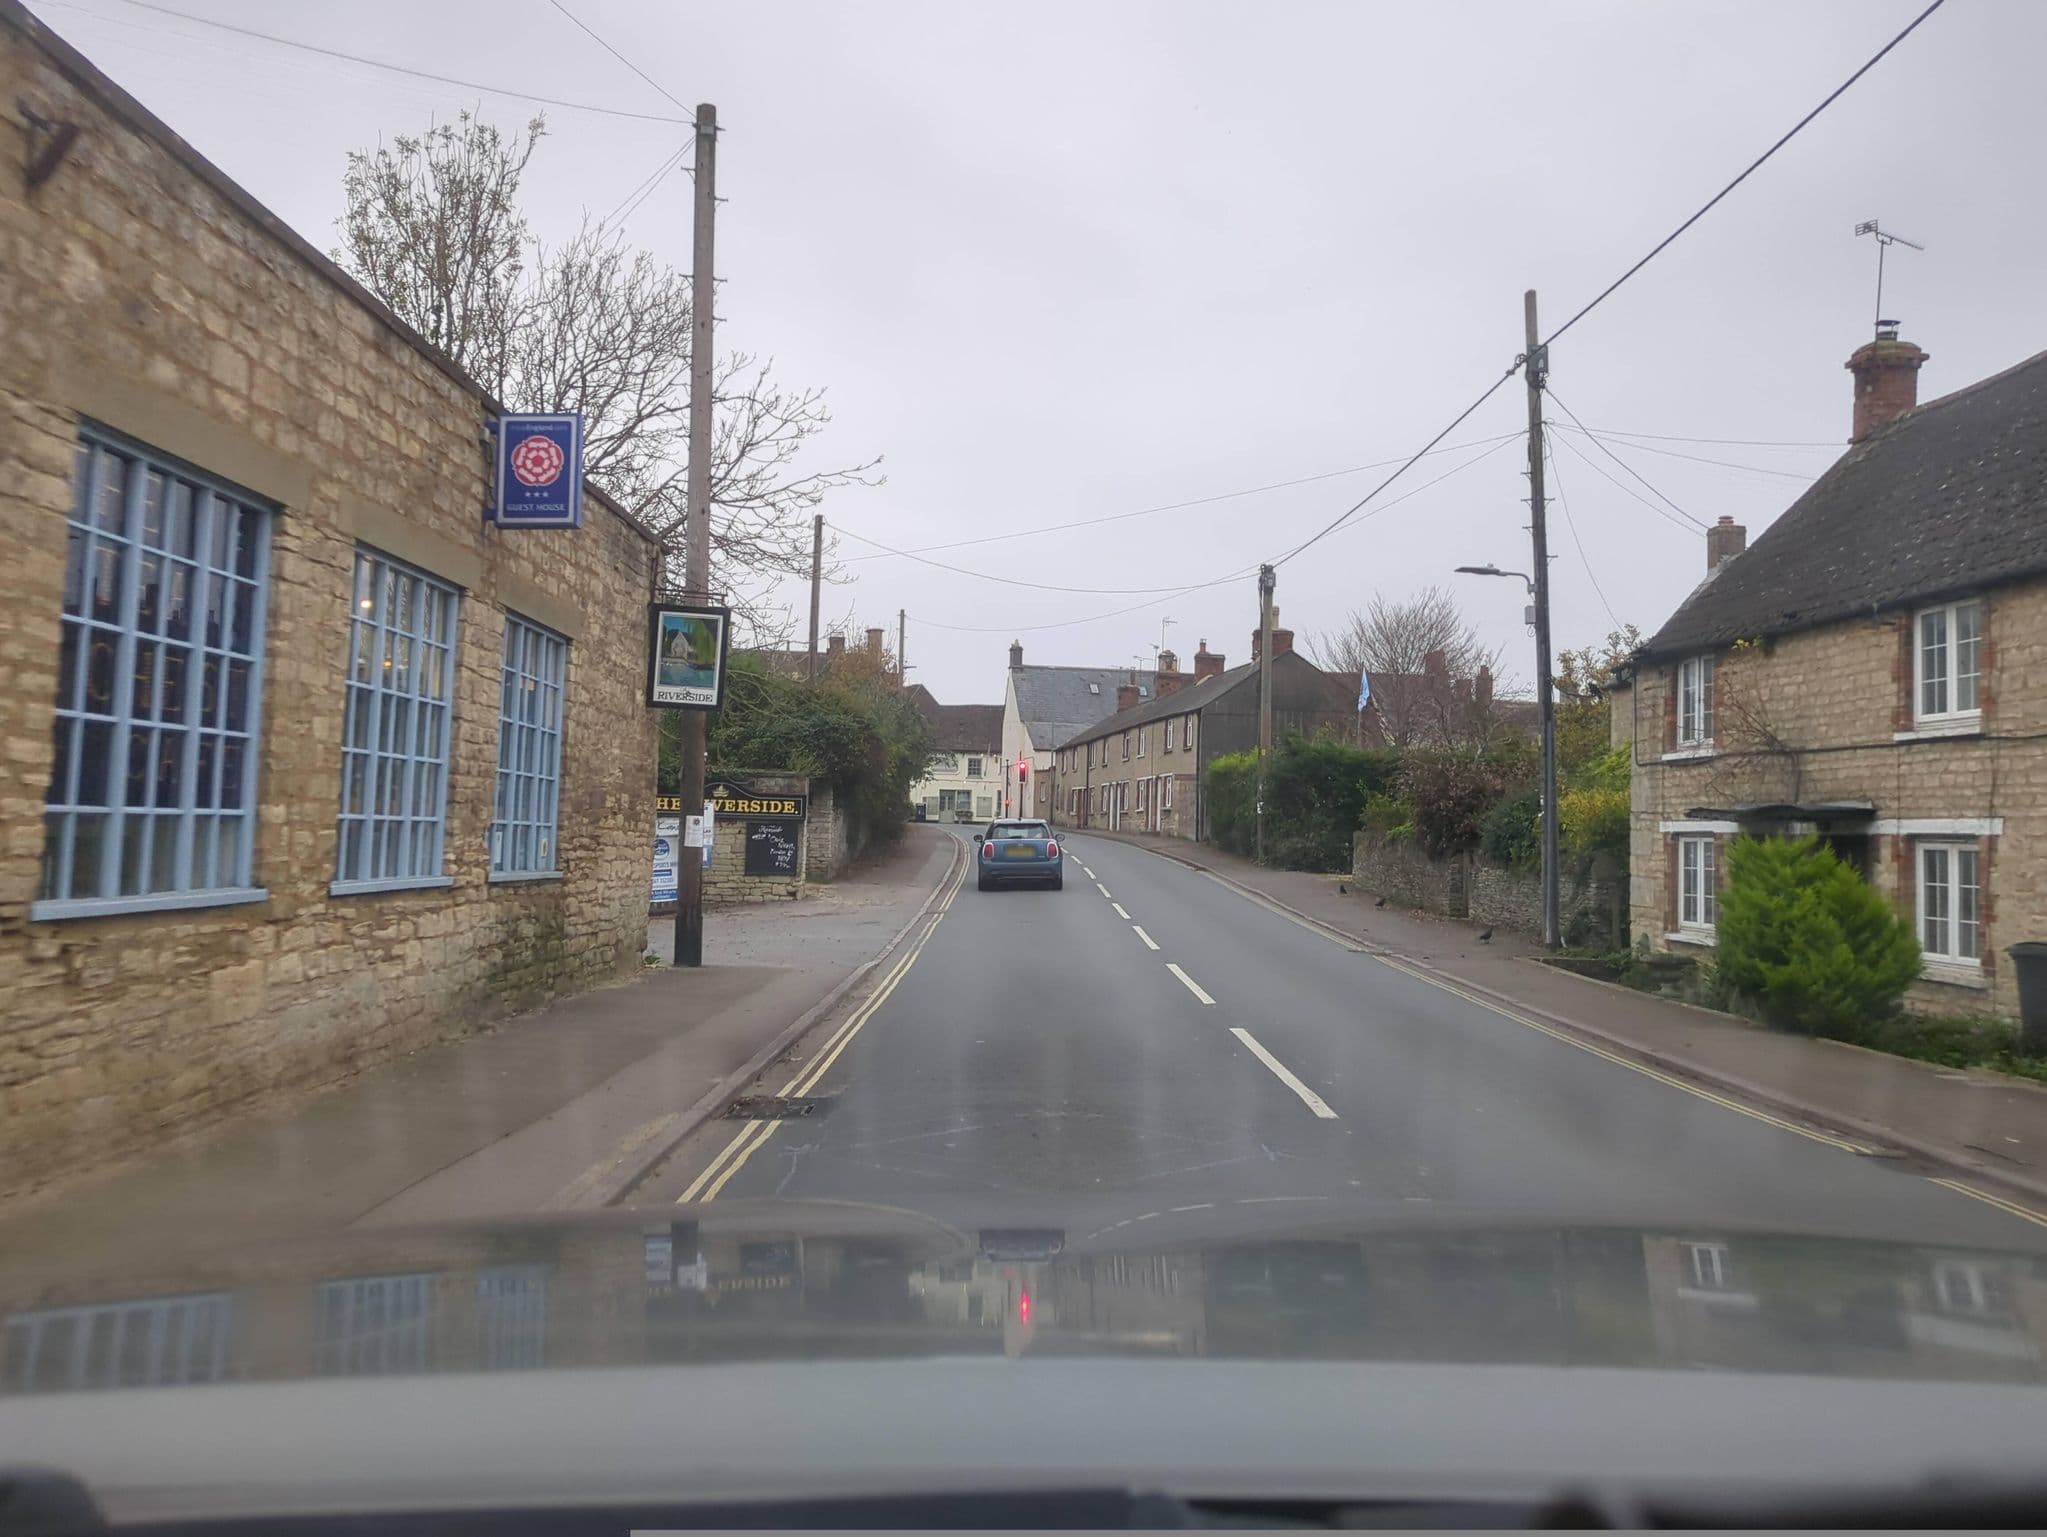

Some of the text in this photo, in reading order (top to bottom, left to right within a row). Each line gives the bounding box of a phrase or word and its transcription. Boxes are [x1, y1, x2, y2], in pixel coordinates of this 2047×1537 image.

[536, 503, 566, 511] HOUSE
[657, 690, 713, 703] RIVERSIDE
[656, 797, 680, 810] HE
